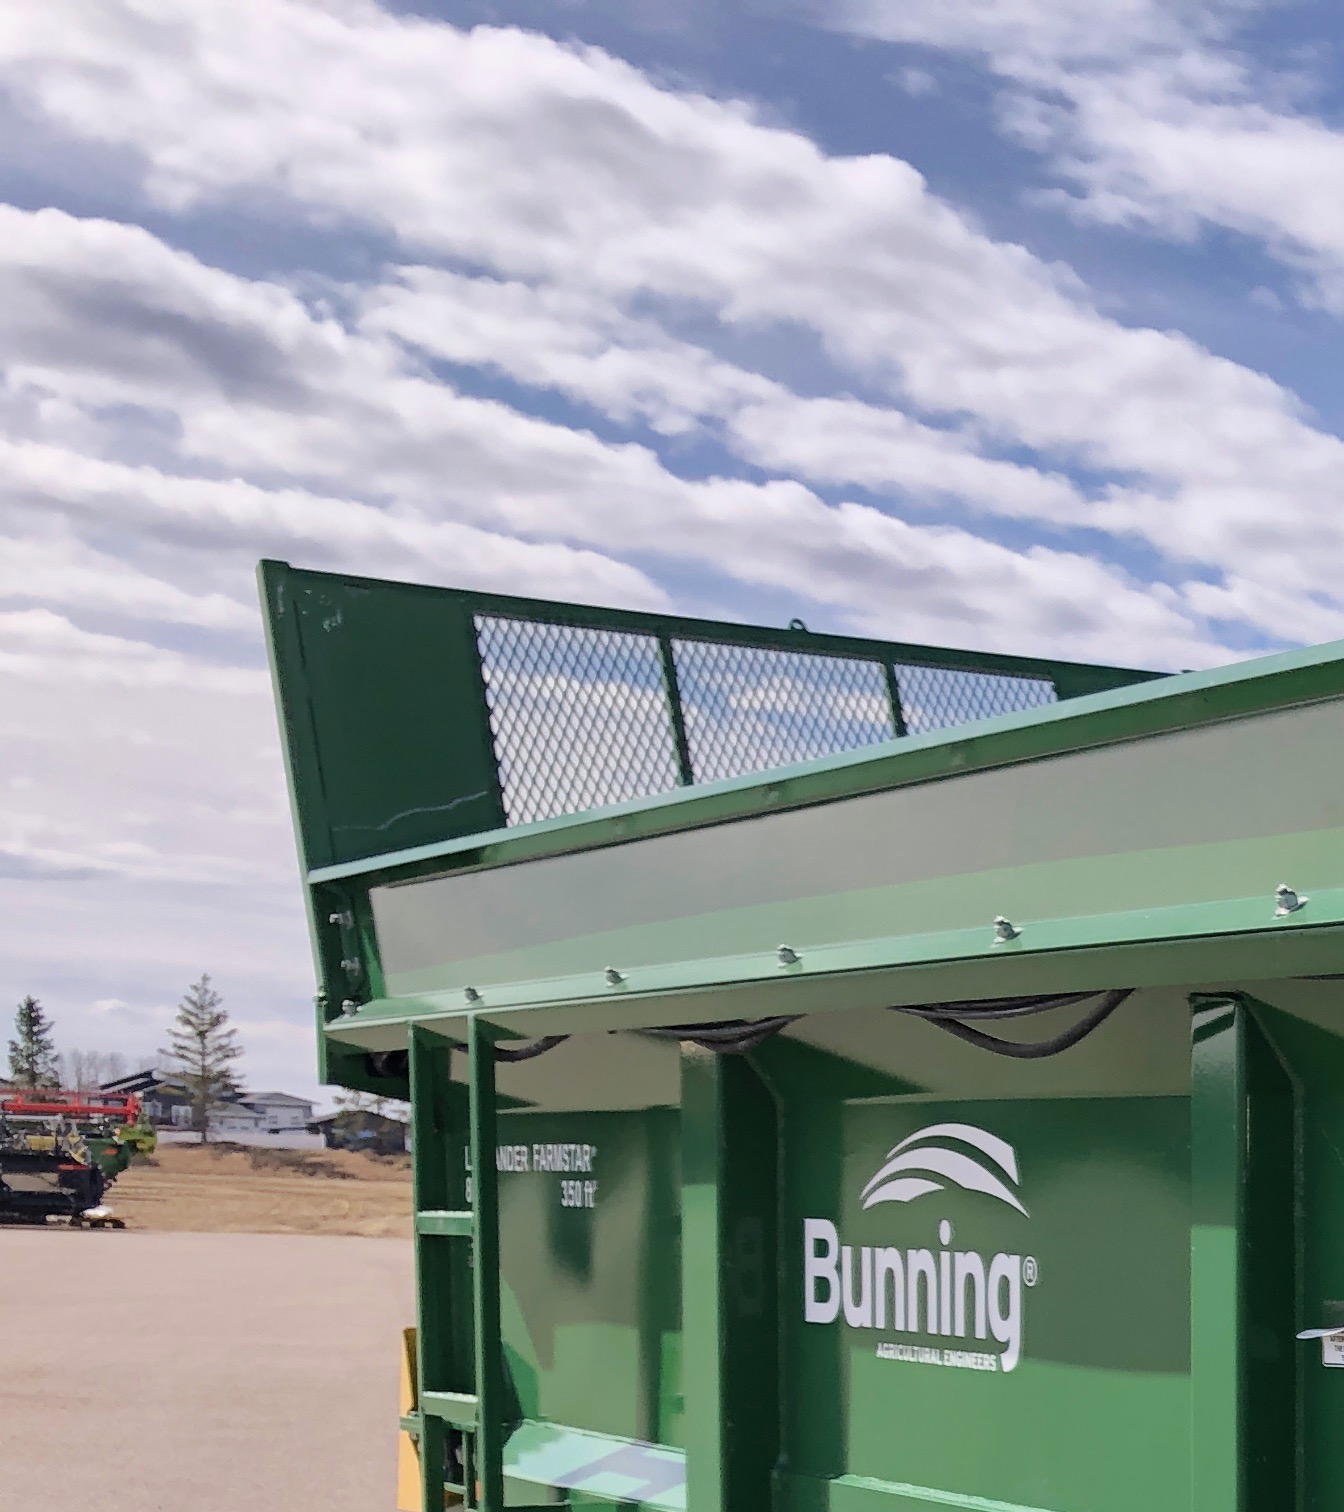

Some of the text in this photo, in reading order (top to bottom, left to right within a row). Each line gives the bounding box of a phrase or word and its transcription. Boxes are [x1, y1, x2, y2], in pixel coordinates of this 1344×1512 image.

[561, 1180, 582, 1208] 350
[876, 1342, 997, 1372] AGRICULTURAL ENGINEERS
